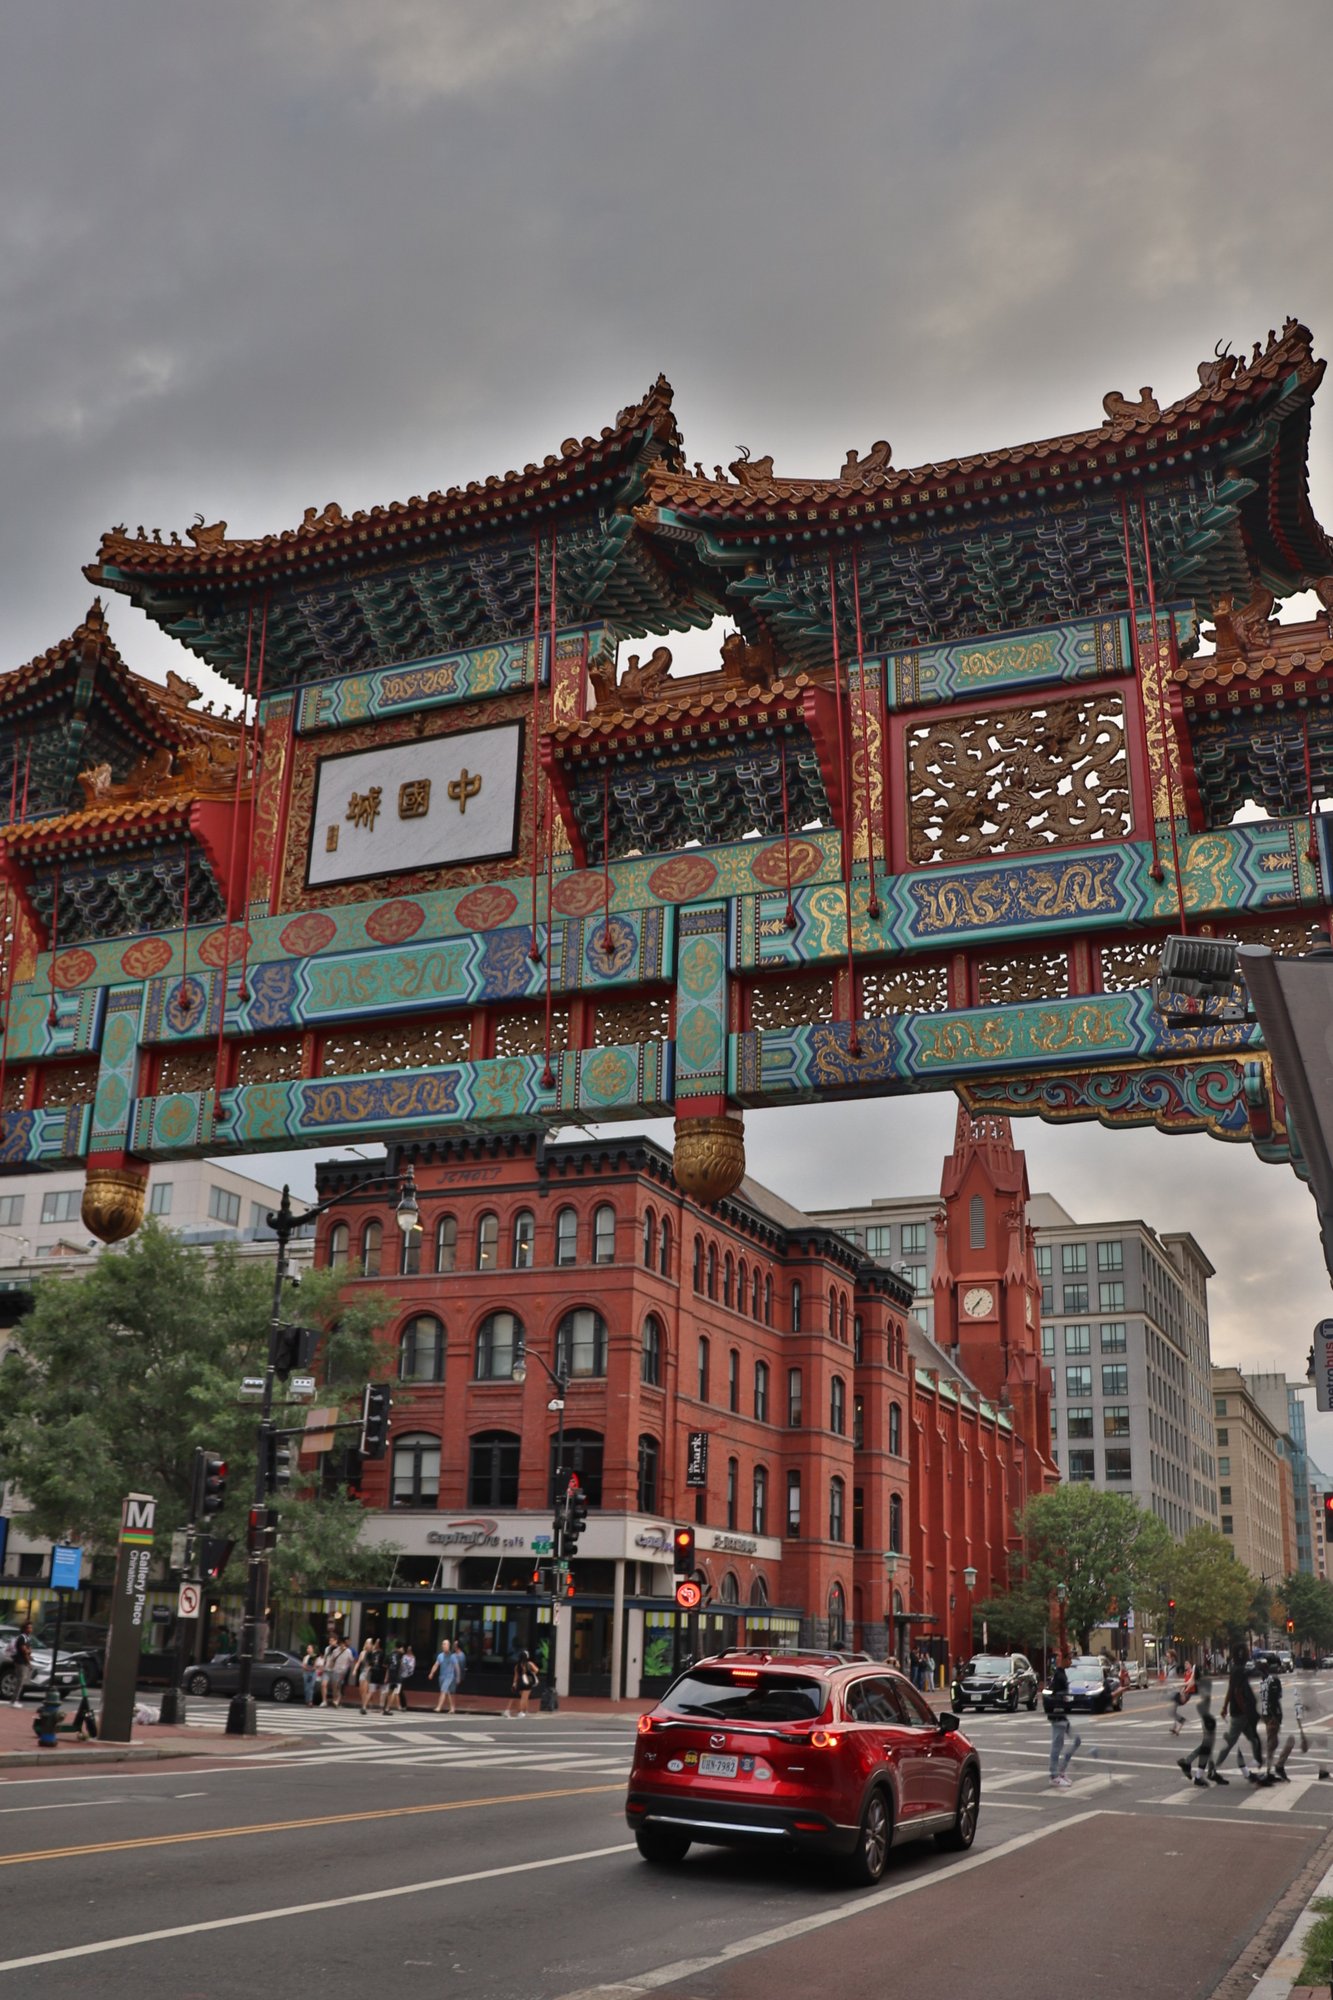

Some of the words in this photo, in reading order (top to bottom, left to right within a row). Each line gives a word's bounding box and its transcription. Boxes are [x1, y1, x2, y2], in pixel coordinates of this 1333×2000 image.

[346, 767, 482, 832] 中國城
[127, 1501, 155, 1528] M
[126, 1550, 138, 1594] Chinatown
[134, 1551, 151, 1591] Gallery
[132, 1594, 145, 1625] Place
